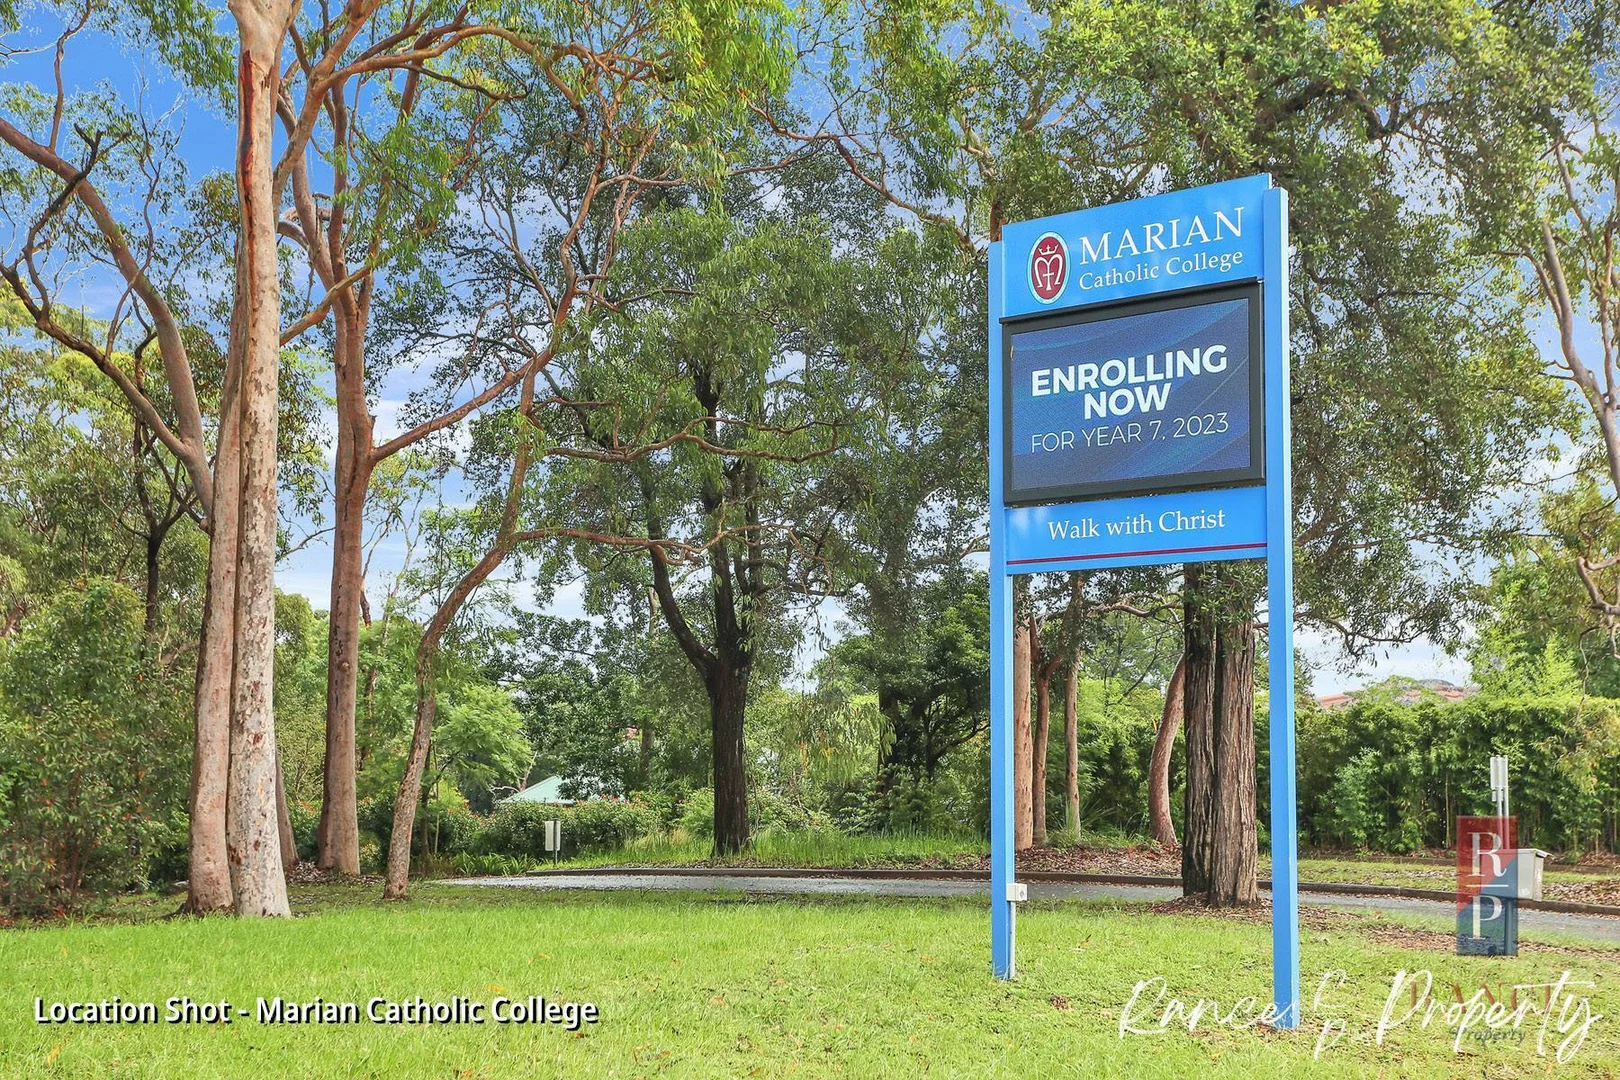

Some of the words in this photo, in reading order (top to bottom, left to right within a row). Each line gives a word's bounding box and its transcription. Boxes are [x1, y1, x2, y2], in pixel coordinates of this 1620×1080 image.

[1079, 207, 1244, 265] MARIAN
[1079, 261, 1159, 290] Catholic
[1166, 250, 1243, 276] College
[1031, 344, 1228, 397] ENROLLING
[1084, 382, 1172, 420] NOW
[1031, 431, 1075, 453] FOR
[1081, 422, 1142, 447] YEAR
[1149, 420, 1166, 441] 7,
[1173, 412, 1229, 438] 2023
[1048, 518, 1100, 541] Walk
[1105, 514, 1153, 536] with
[1158, 509, 1225, 532] Christ
